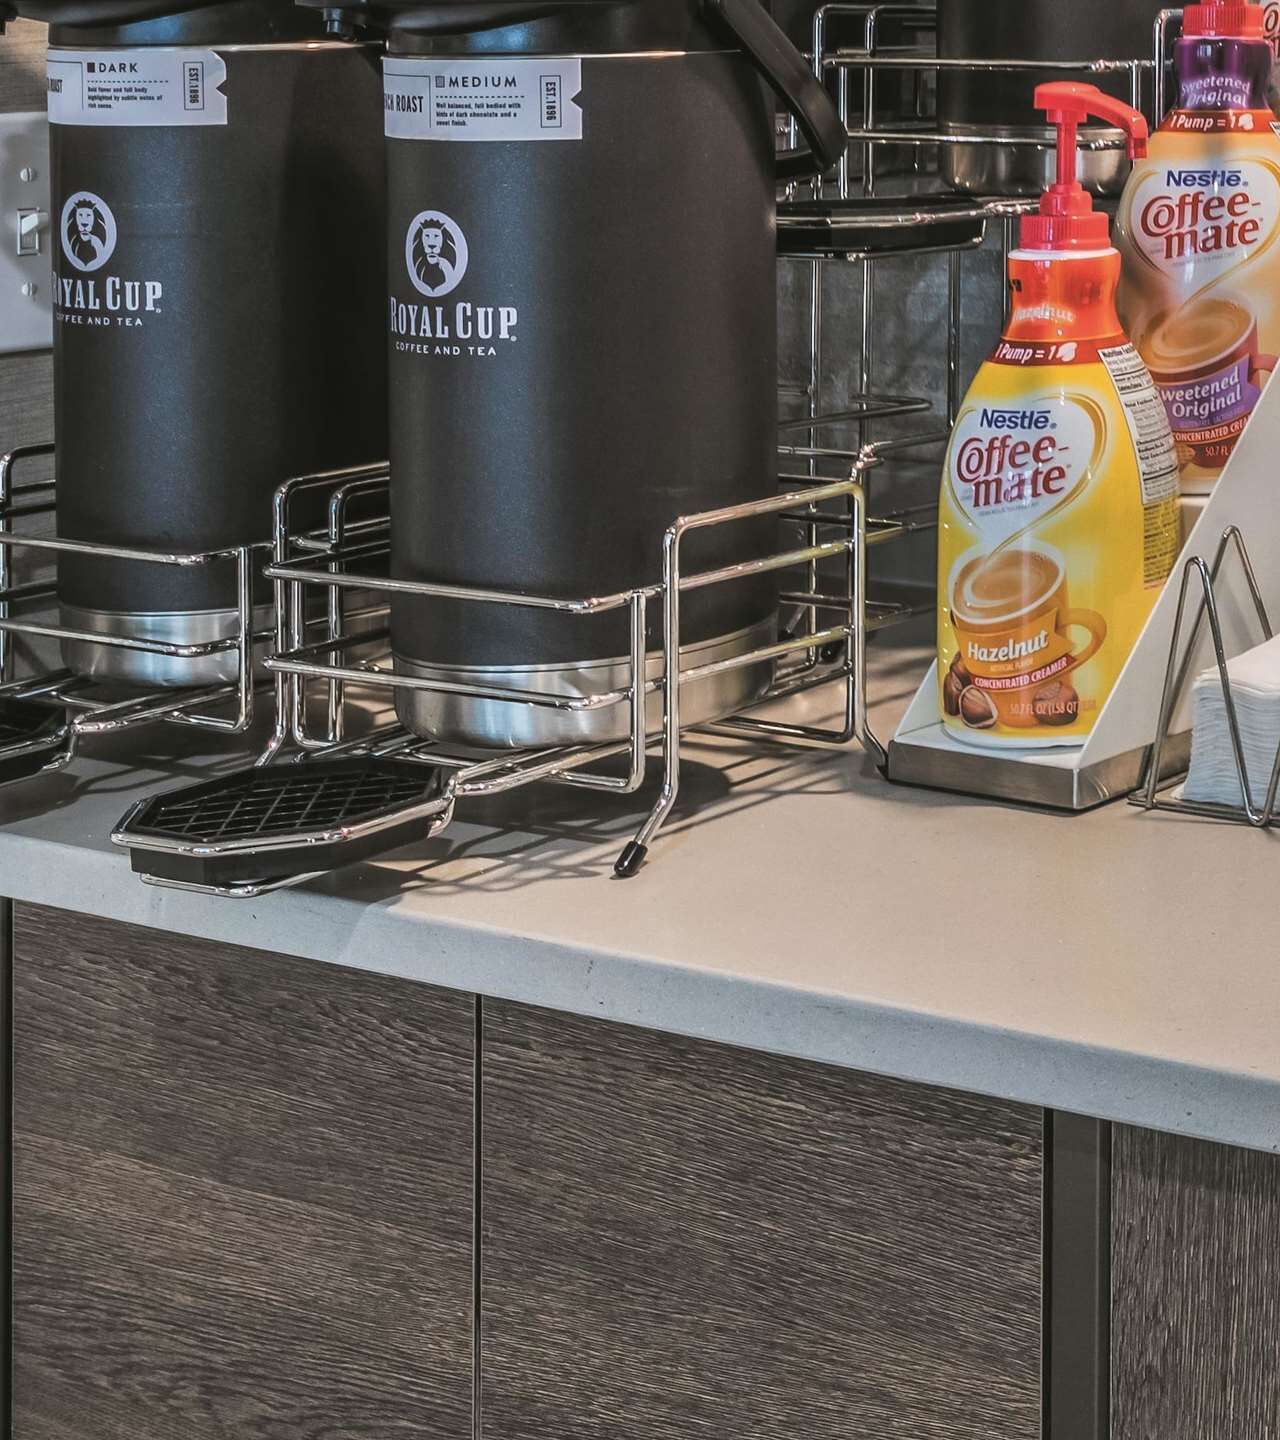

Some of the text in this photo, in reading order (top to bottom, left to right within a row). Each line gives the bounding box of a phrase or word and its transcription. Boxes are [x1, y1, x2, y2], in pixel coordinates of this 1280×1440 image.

[98, 62, 139, 73] DARK
[448, 76, 517, 88] MEDIUM
[1181, 75, 1251, 97] Sweetened
[396, 95, 424, 114] ROAST
[1186, 88, 1248, 110] Original
[1177, 114, 1214, 132] Pump
[1163, 218, 1259, 260] mate
[105, 276, 163, 312] CUP
[87, 317, 111, 326] AND
[117, 318, 143, 327] TEA
[390, 295, 518, 339] ROYAL CUP
[395, 340, 497, 356] COFFEE AND TEA
[1000, 343, 1033, 364] Pump
[1047, 345, 1057, 360] 1
[1160, 366, 1240, 402] weetened
[1172, 384, 1242, 420] Original
[1230, 416, 1249, 433] CREA
[973, 465, 1066, 508] mate
[967, 629, 1049, 662] Hazelnut
[974, 656, 1068, 690] CONCENTRATED CREAMER
[1027, 703, 1035, 715] FL
